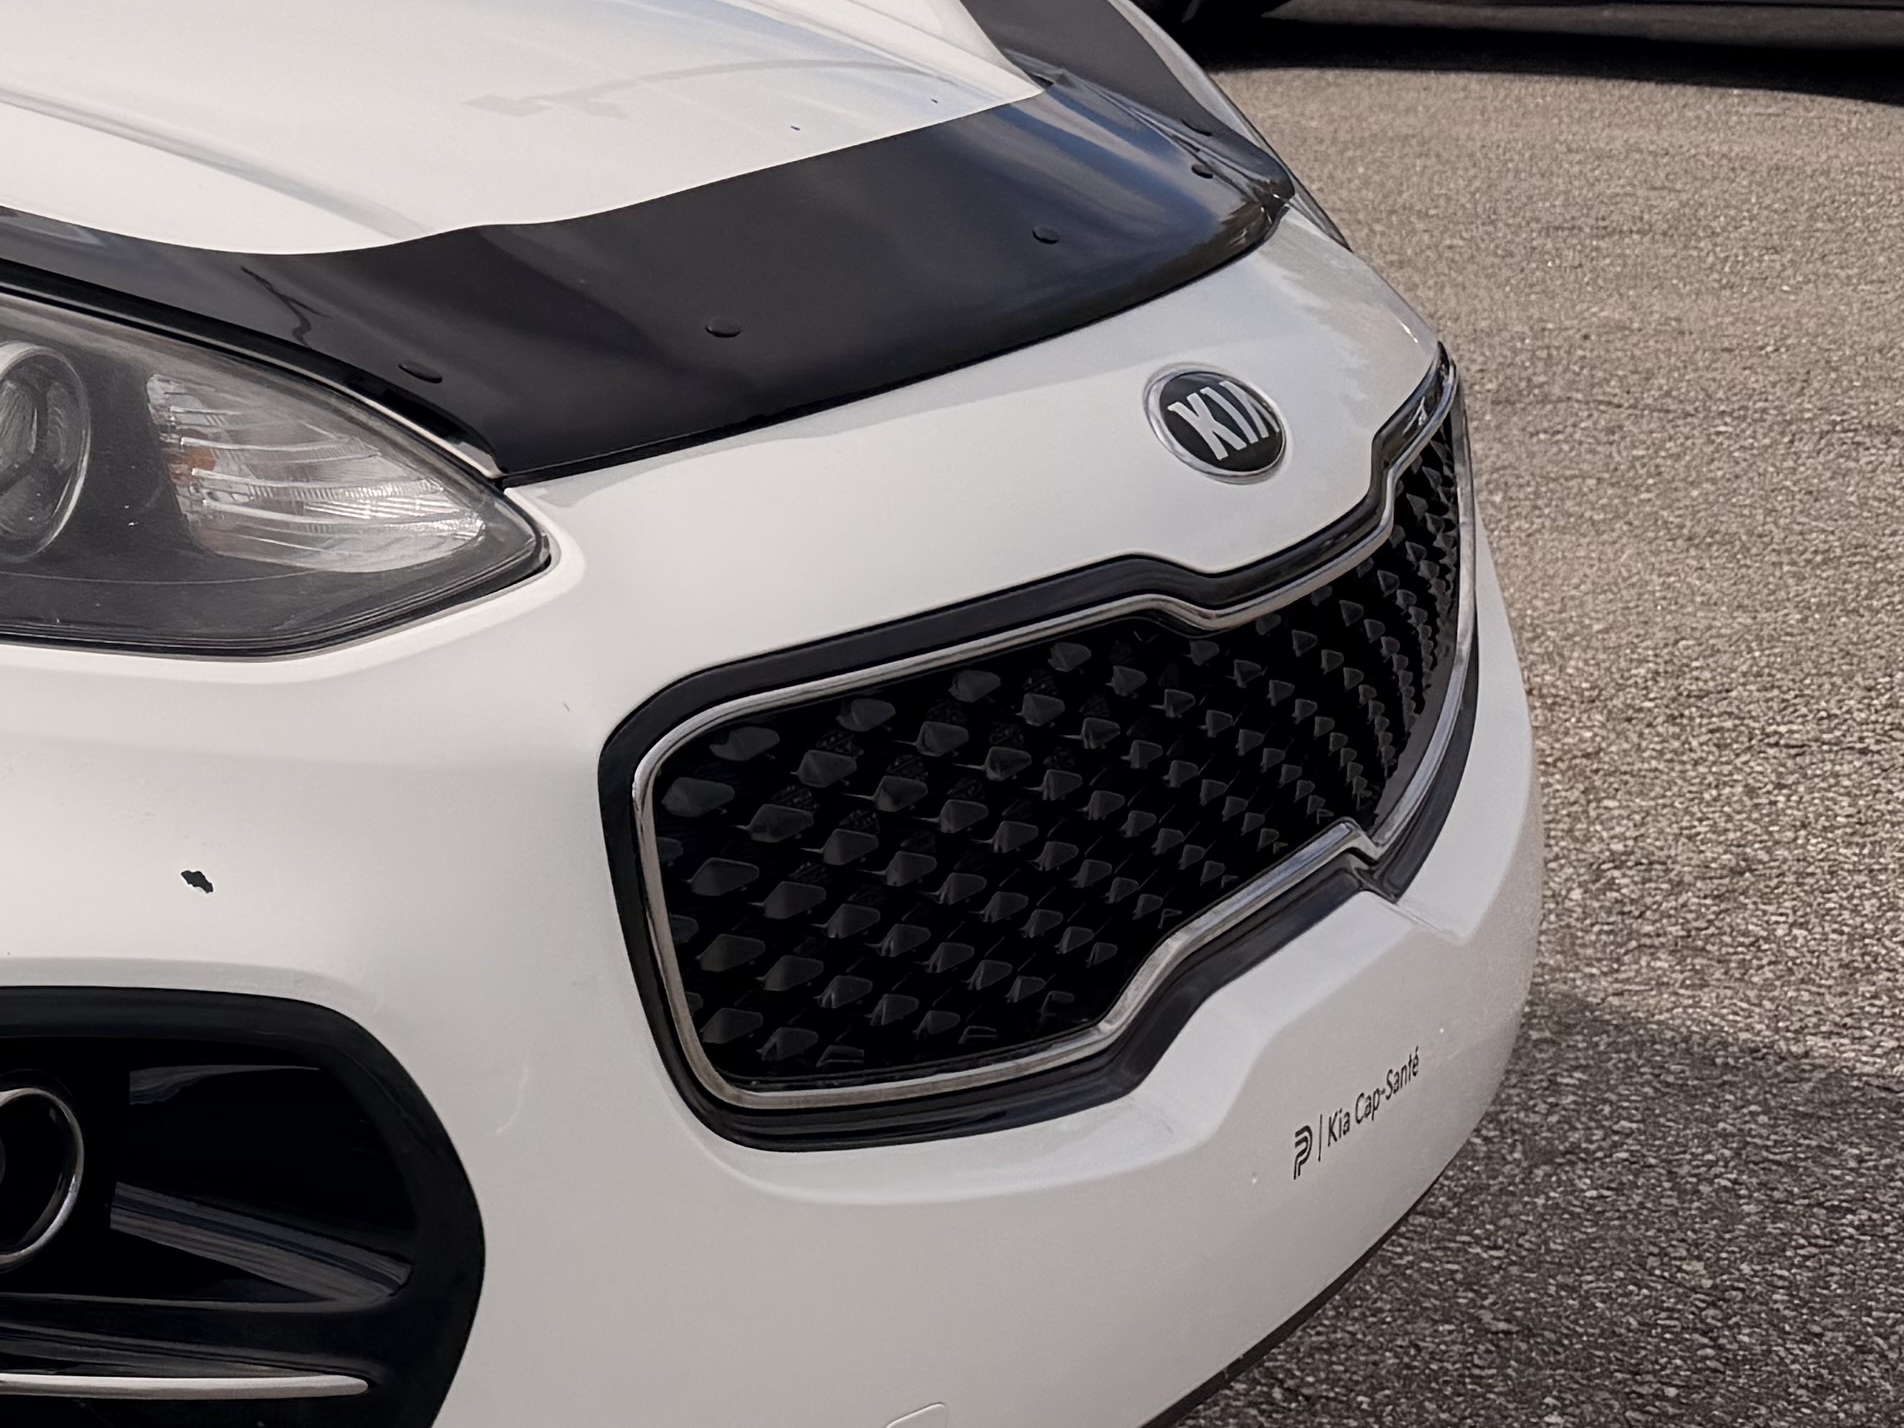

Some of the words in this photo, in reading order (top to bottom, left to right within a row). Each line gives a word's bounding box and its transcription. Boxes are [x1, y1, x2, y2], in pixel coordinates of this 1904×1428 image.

[1167, 379, 1280, 461] KIA
[1326, 1110, 1352, 1148] Kia
[1354, 1045, 1421, 1126] Cap-Santé
